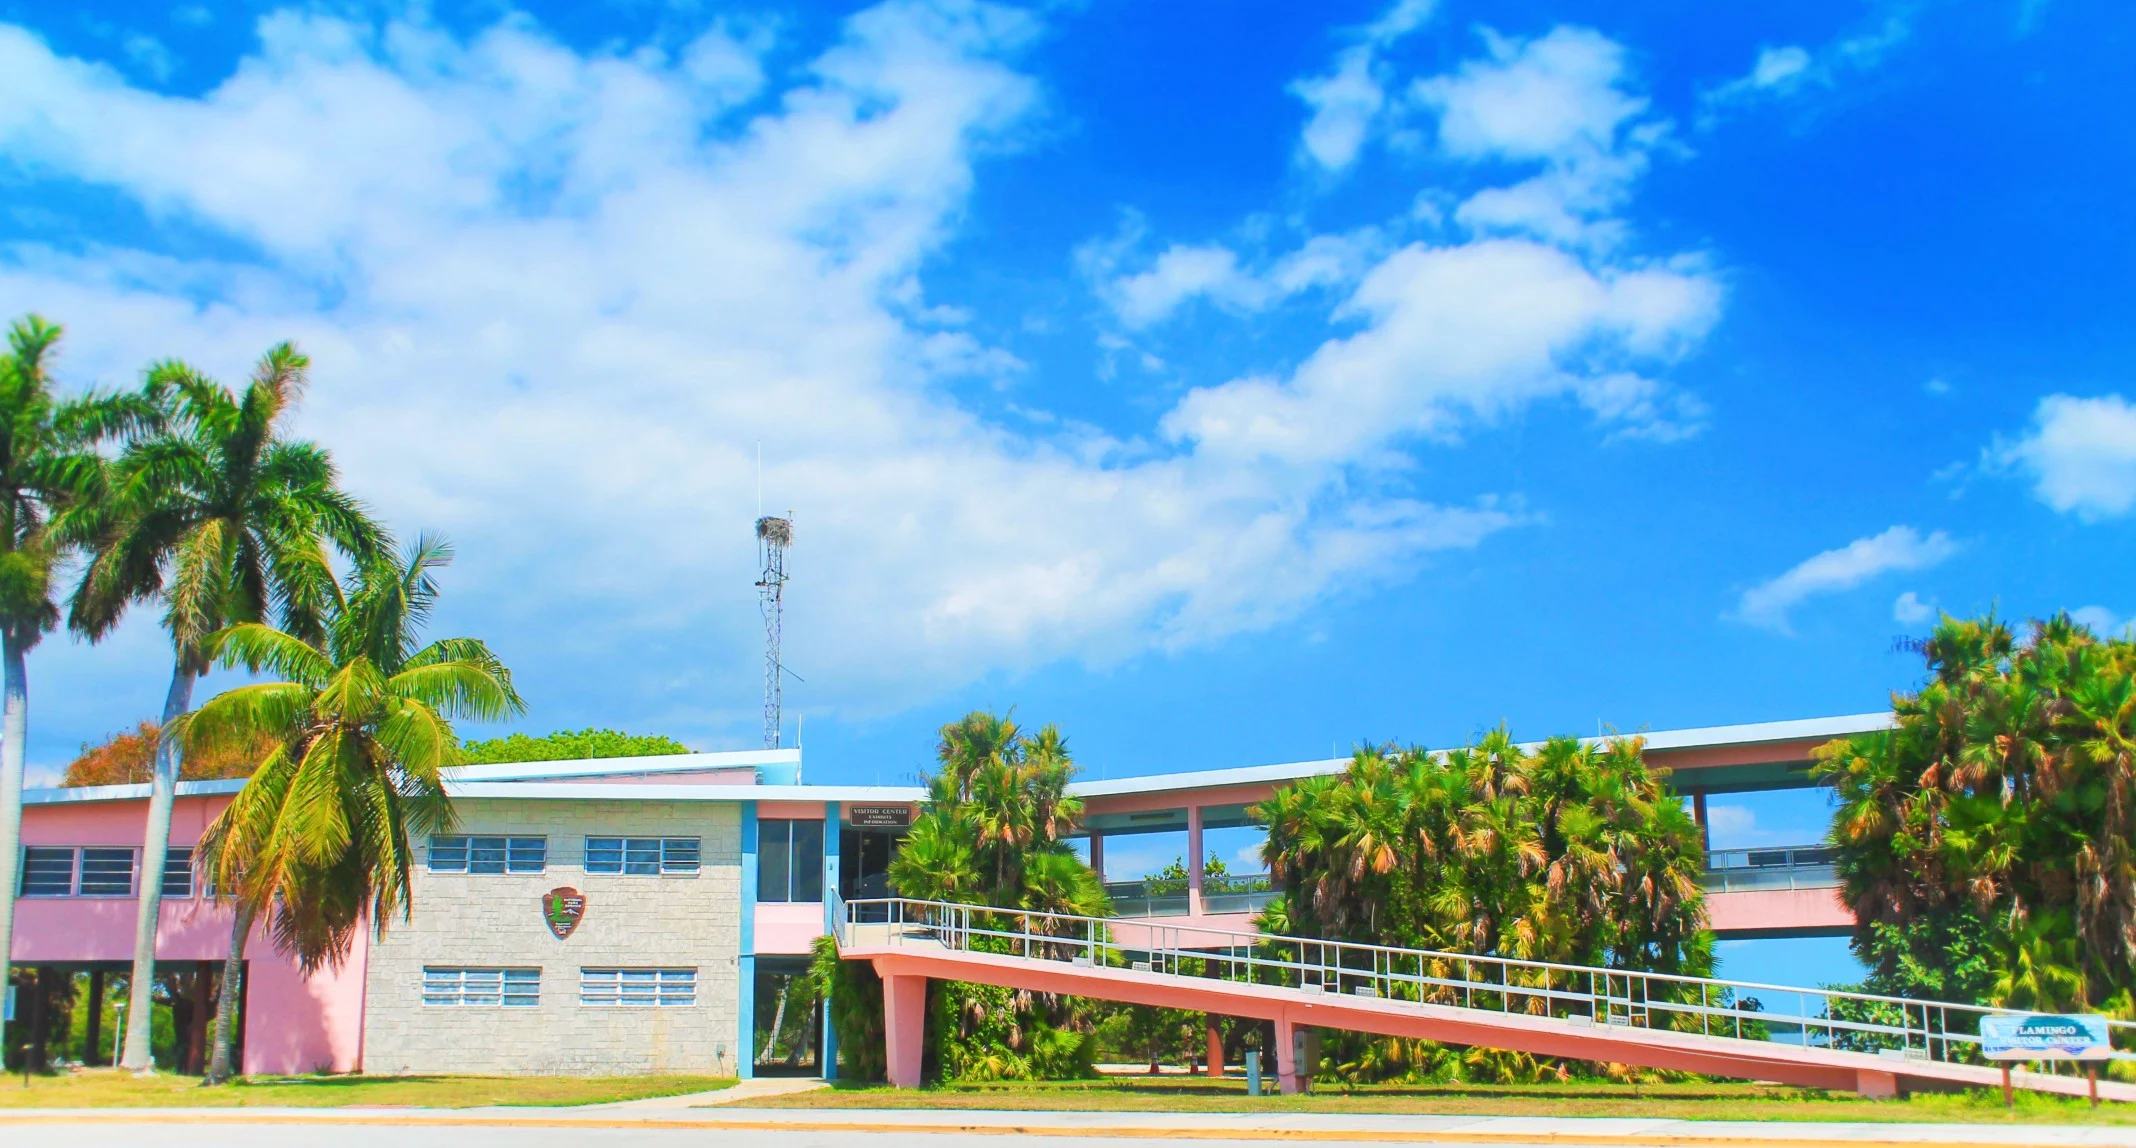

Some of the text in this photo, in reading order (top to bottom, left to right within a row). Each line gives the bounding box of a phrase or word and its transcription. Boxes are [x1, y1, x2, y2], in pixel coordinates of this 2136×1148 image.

[2012, 1026, 2076, 1035] FLAMINGO
[2000, 1036, 2090, 1045] VISITOR CENTER
